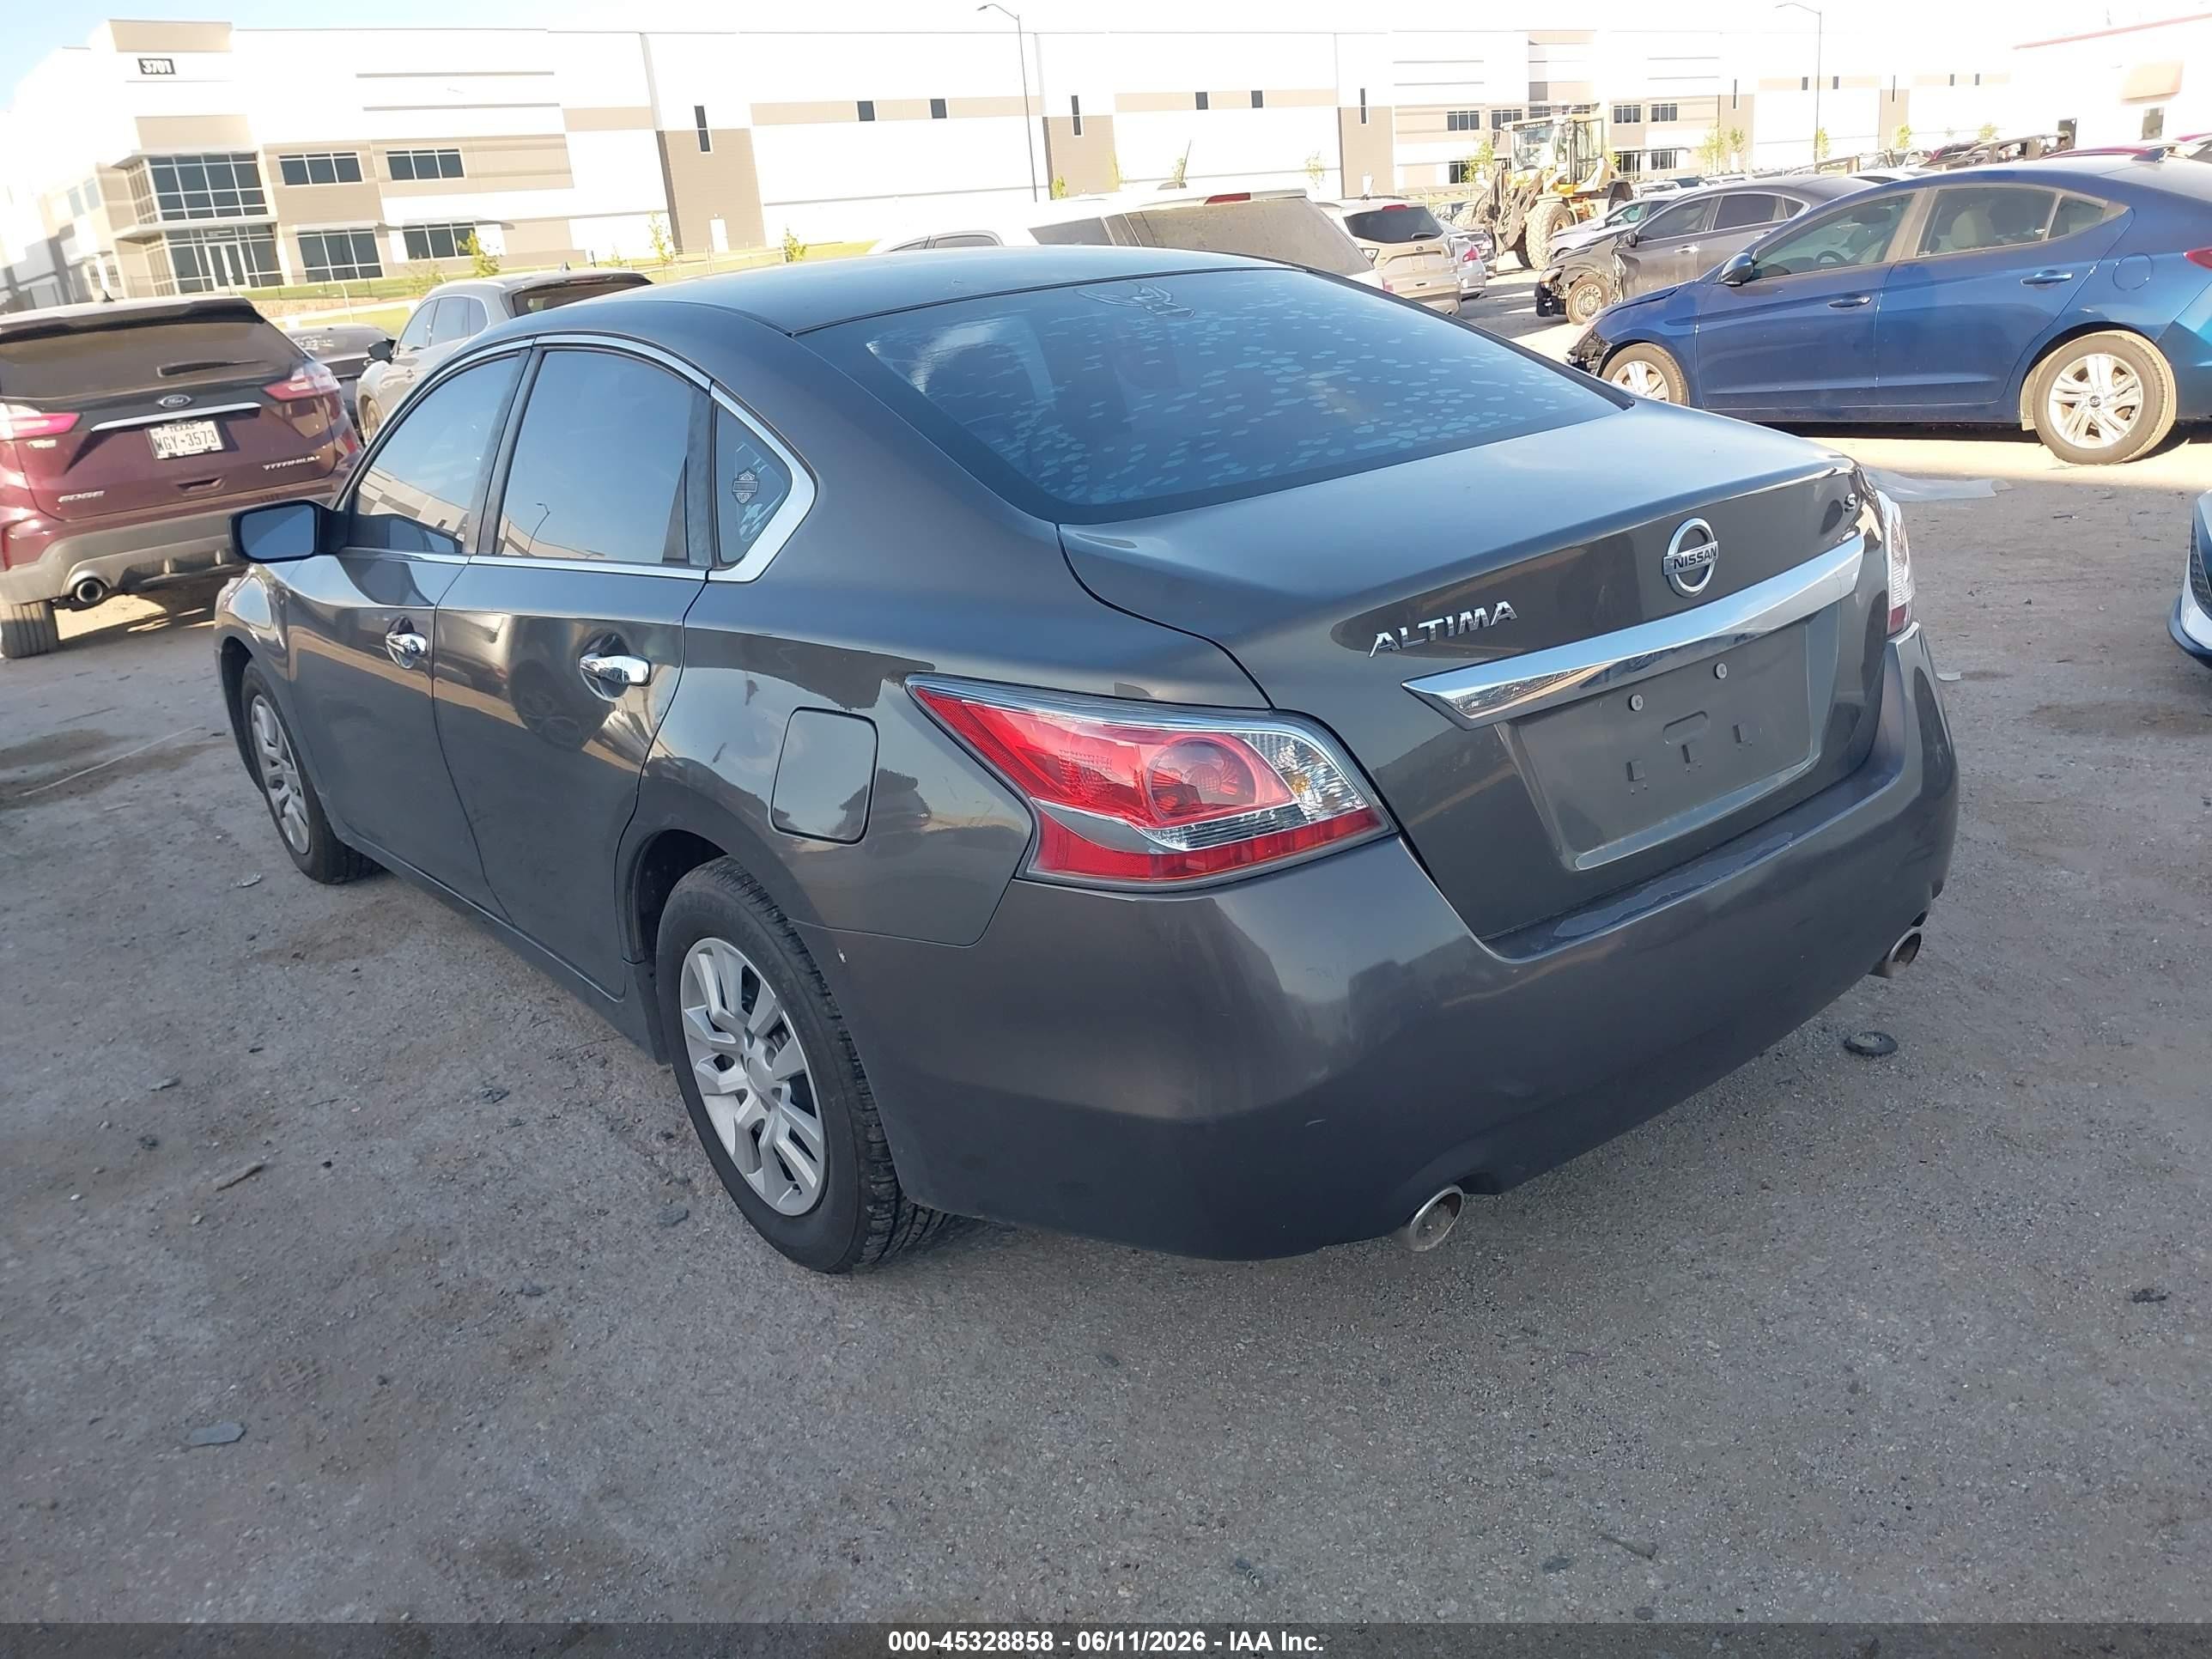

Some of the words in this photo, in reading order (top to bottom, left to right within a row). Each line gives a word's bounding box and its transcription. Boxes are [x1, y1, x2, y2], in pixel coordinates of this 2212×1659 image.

[1844, 493, 1856, 513] S
[1674, 544, 1717, 570] NISSAN
[1369, 600, 1517, 658] ALTIMA
